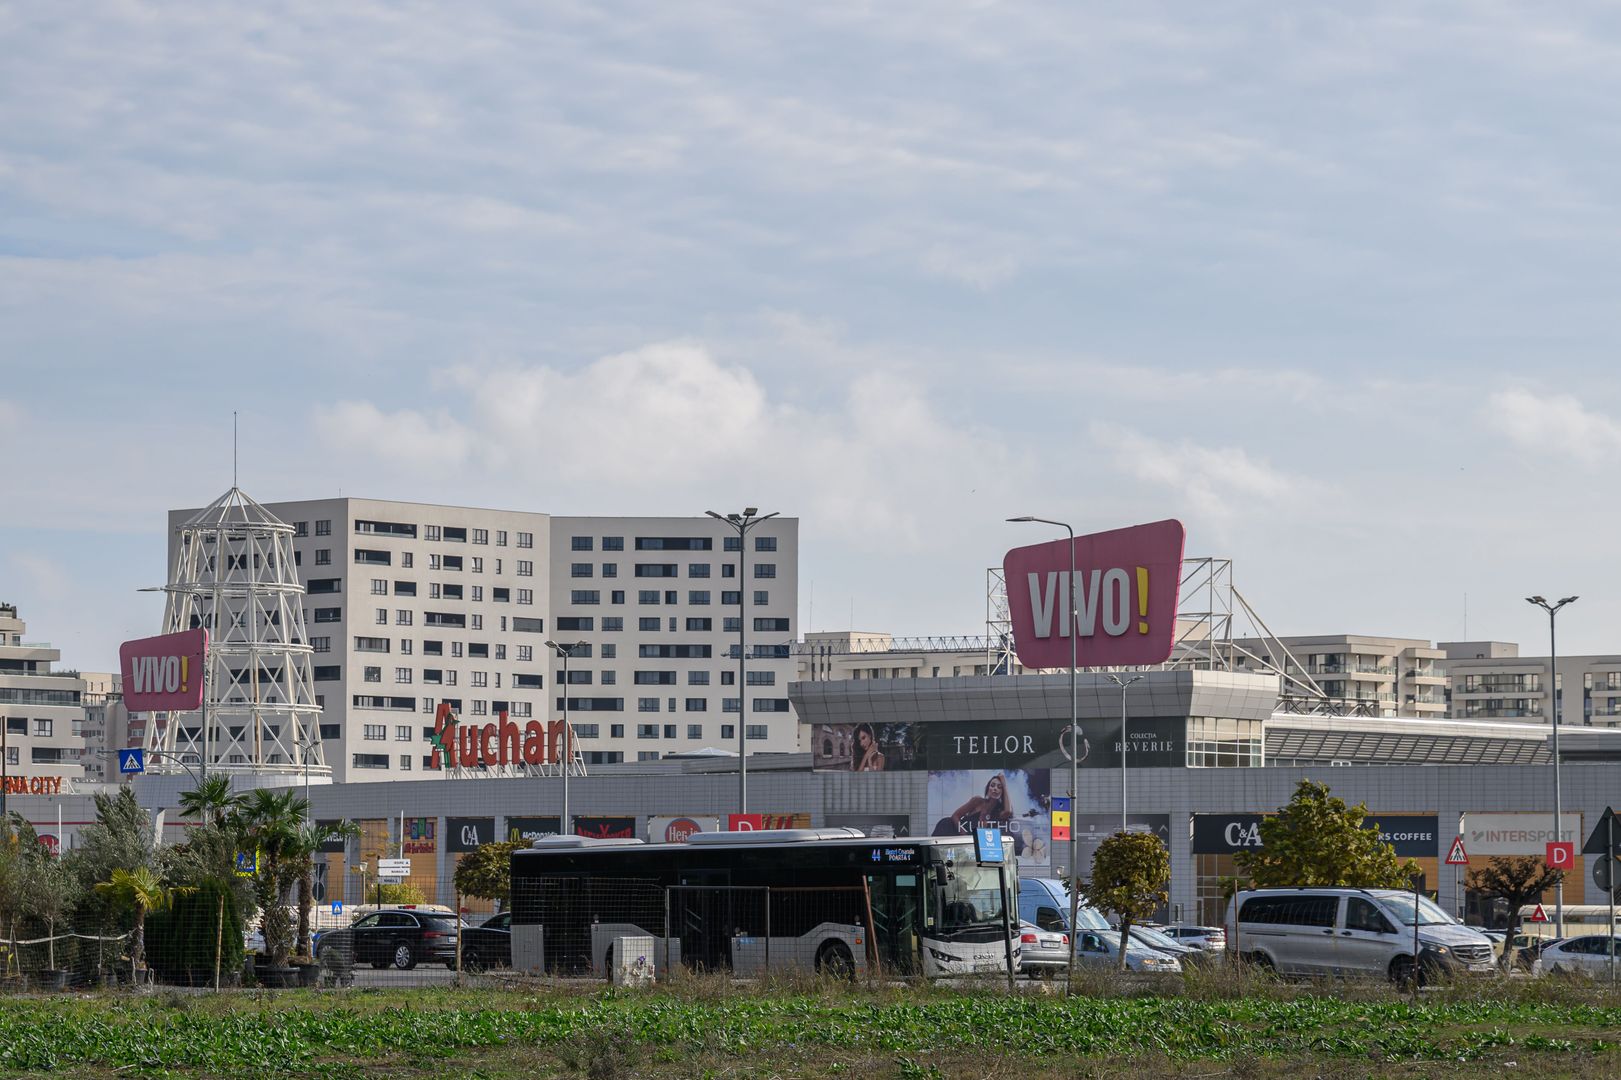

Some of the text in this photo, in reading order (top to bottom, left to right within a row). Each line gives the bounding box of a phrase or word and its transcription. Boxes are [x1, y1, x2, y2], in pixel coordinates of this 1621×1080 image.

[1028, 566, 1149, 638] VIVO!
[132, 655, 188, 693] VIVO!
[430, 702, 573, 769] Auchan
[953, 736, 1035, 754] TEILOR
[1115, 741, 1174, 752] REVERIE
[461, 825, 480, 846] C&A
[1224, 822, 1264, 846] C&A
[1393, 832, 1432, 841] COFFEE
[871, 848, 881, 862] 44
[1553, 847, 1567, 864] D
